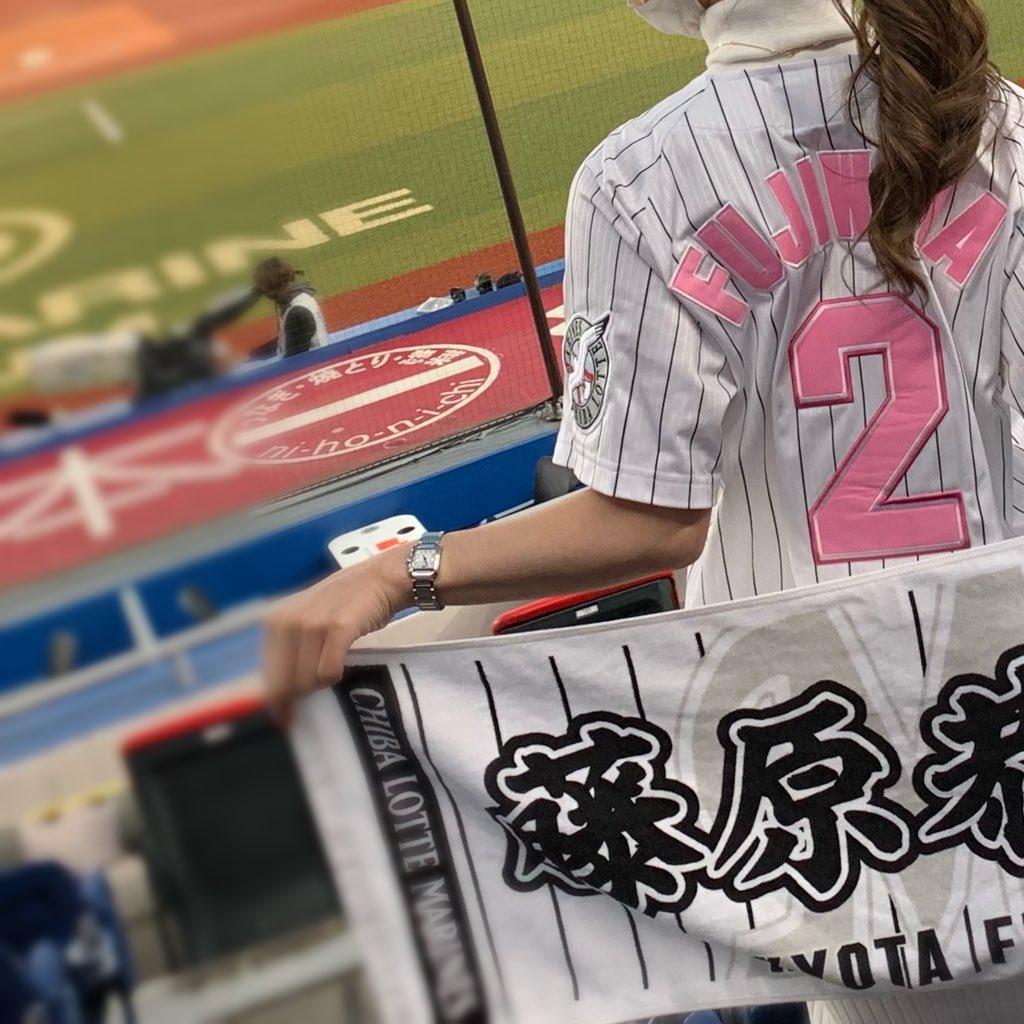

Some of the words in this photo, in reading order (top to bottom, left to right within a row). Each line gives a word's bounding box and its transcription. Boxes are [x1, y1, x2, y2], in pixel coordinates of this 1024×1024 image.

[788, 291, 972, 566] 2
[349, 687, 408, 770] CHIBA
[382, 774, 440, 873] LOTTE
